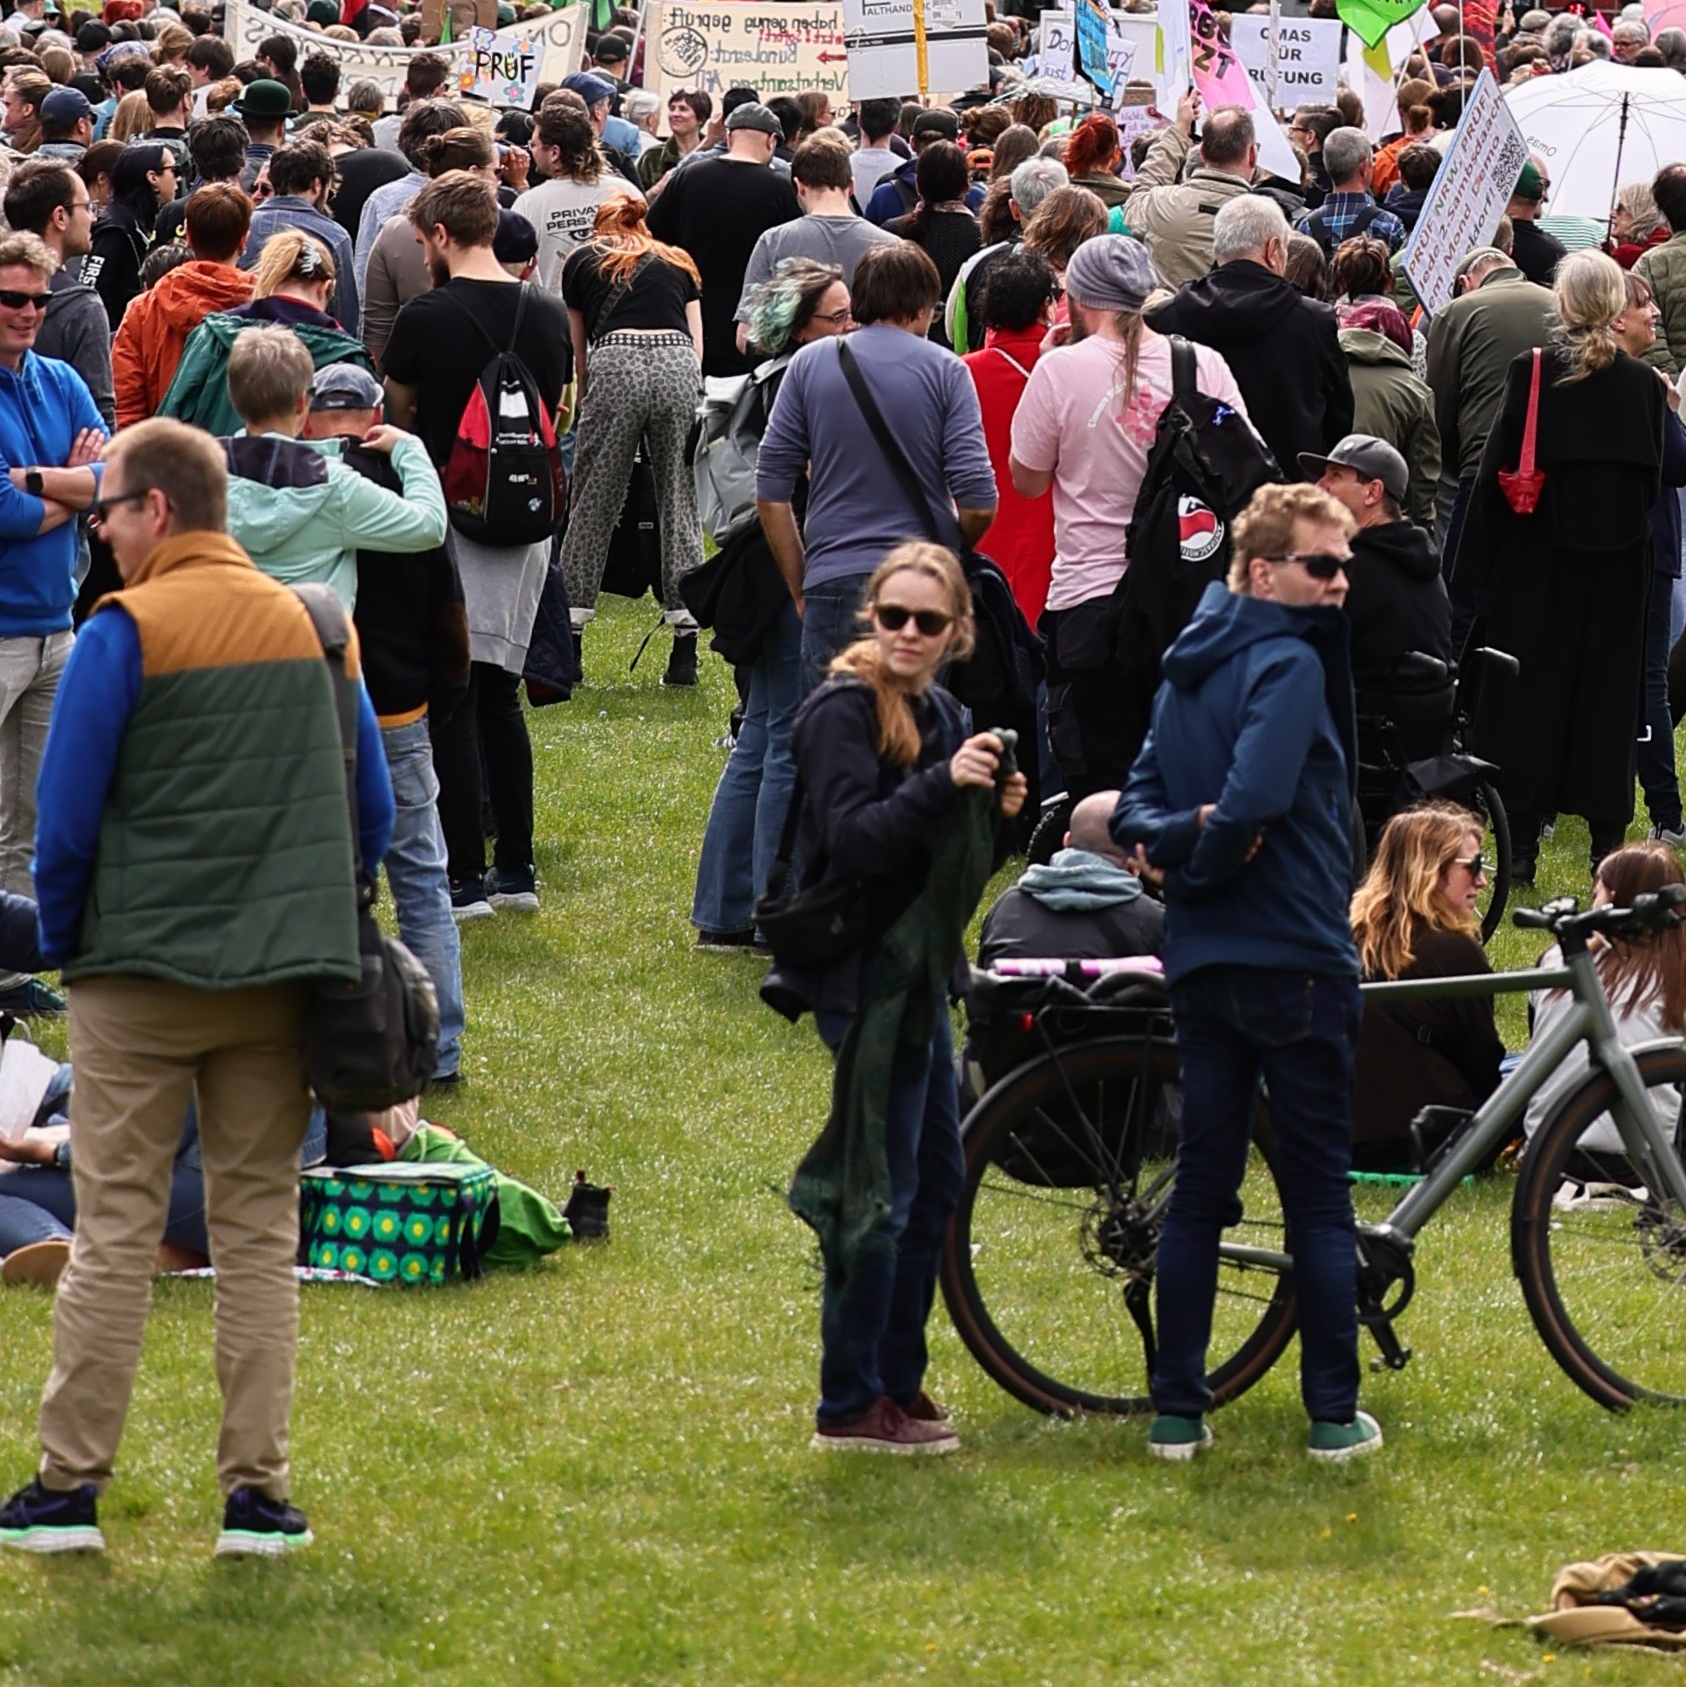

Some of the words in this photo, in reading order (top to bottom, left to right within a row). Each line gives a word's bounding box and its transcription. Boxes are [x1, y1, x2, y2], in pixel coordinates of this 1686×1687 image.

[475, 49, 536, 85] PRÜF
[1279, 45, 1303, 62] ÜR
[1408, 218, 1438, 277] PRÜF
[1459, 88, 1490, 153] PRÜF!
[1427, 275, 1445, 310] em
[1442, 202, 1473, 270] Mond
[1471, 134, 1501, 200] Demo
[1418, 244, 1442, 294] Jede
